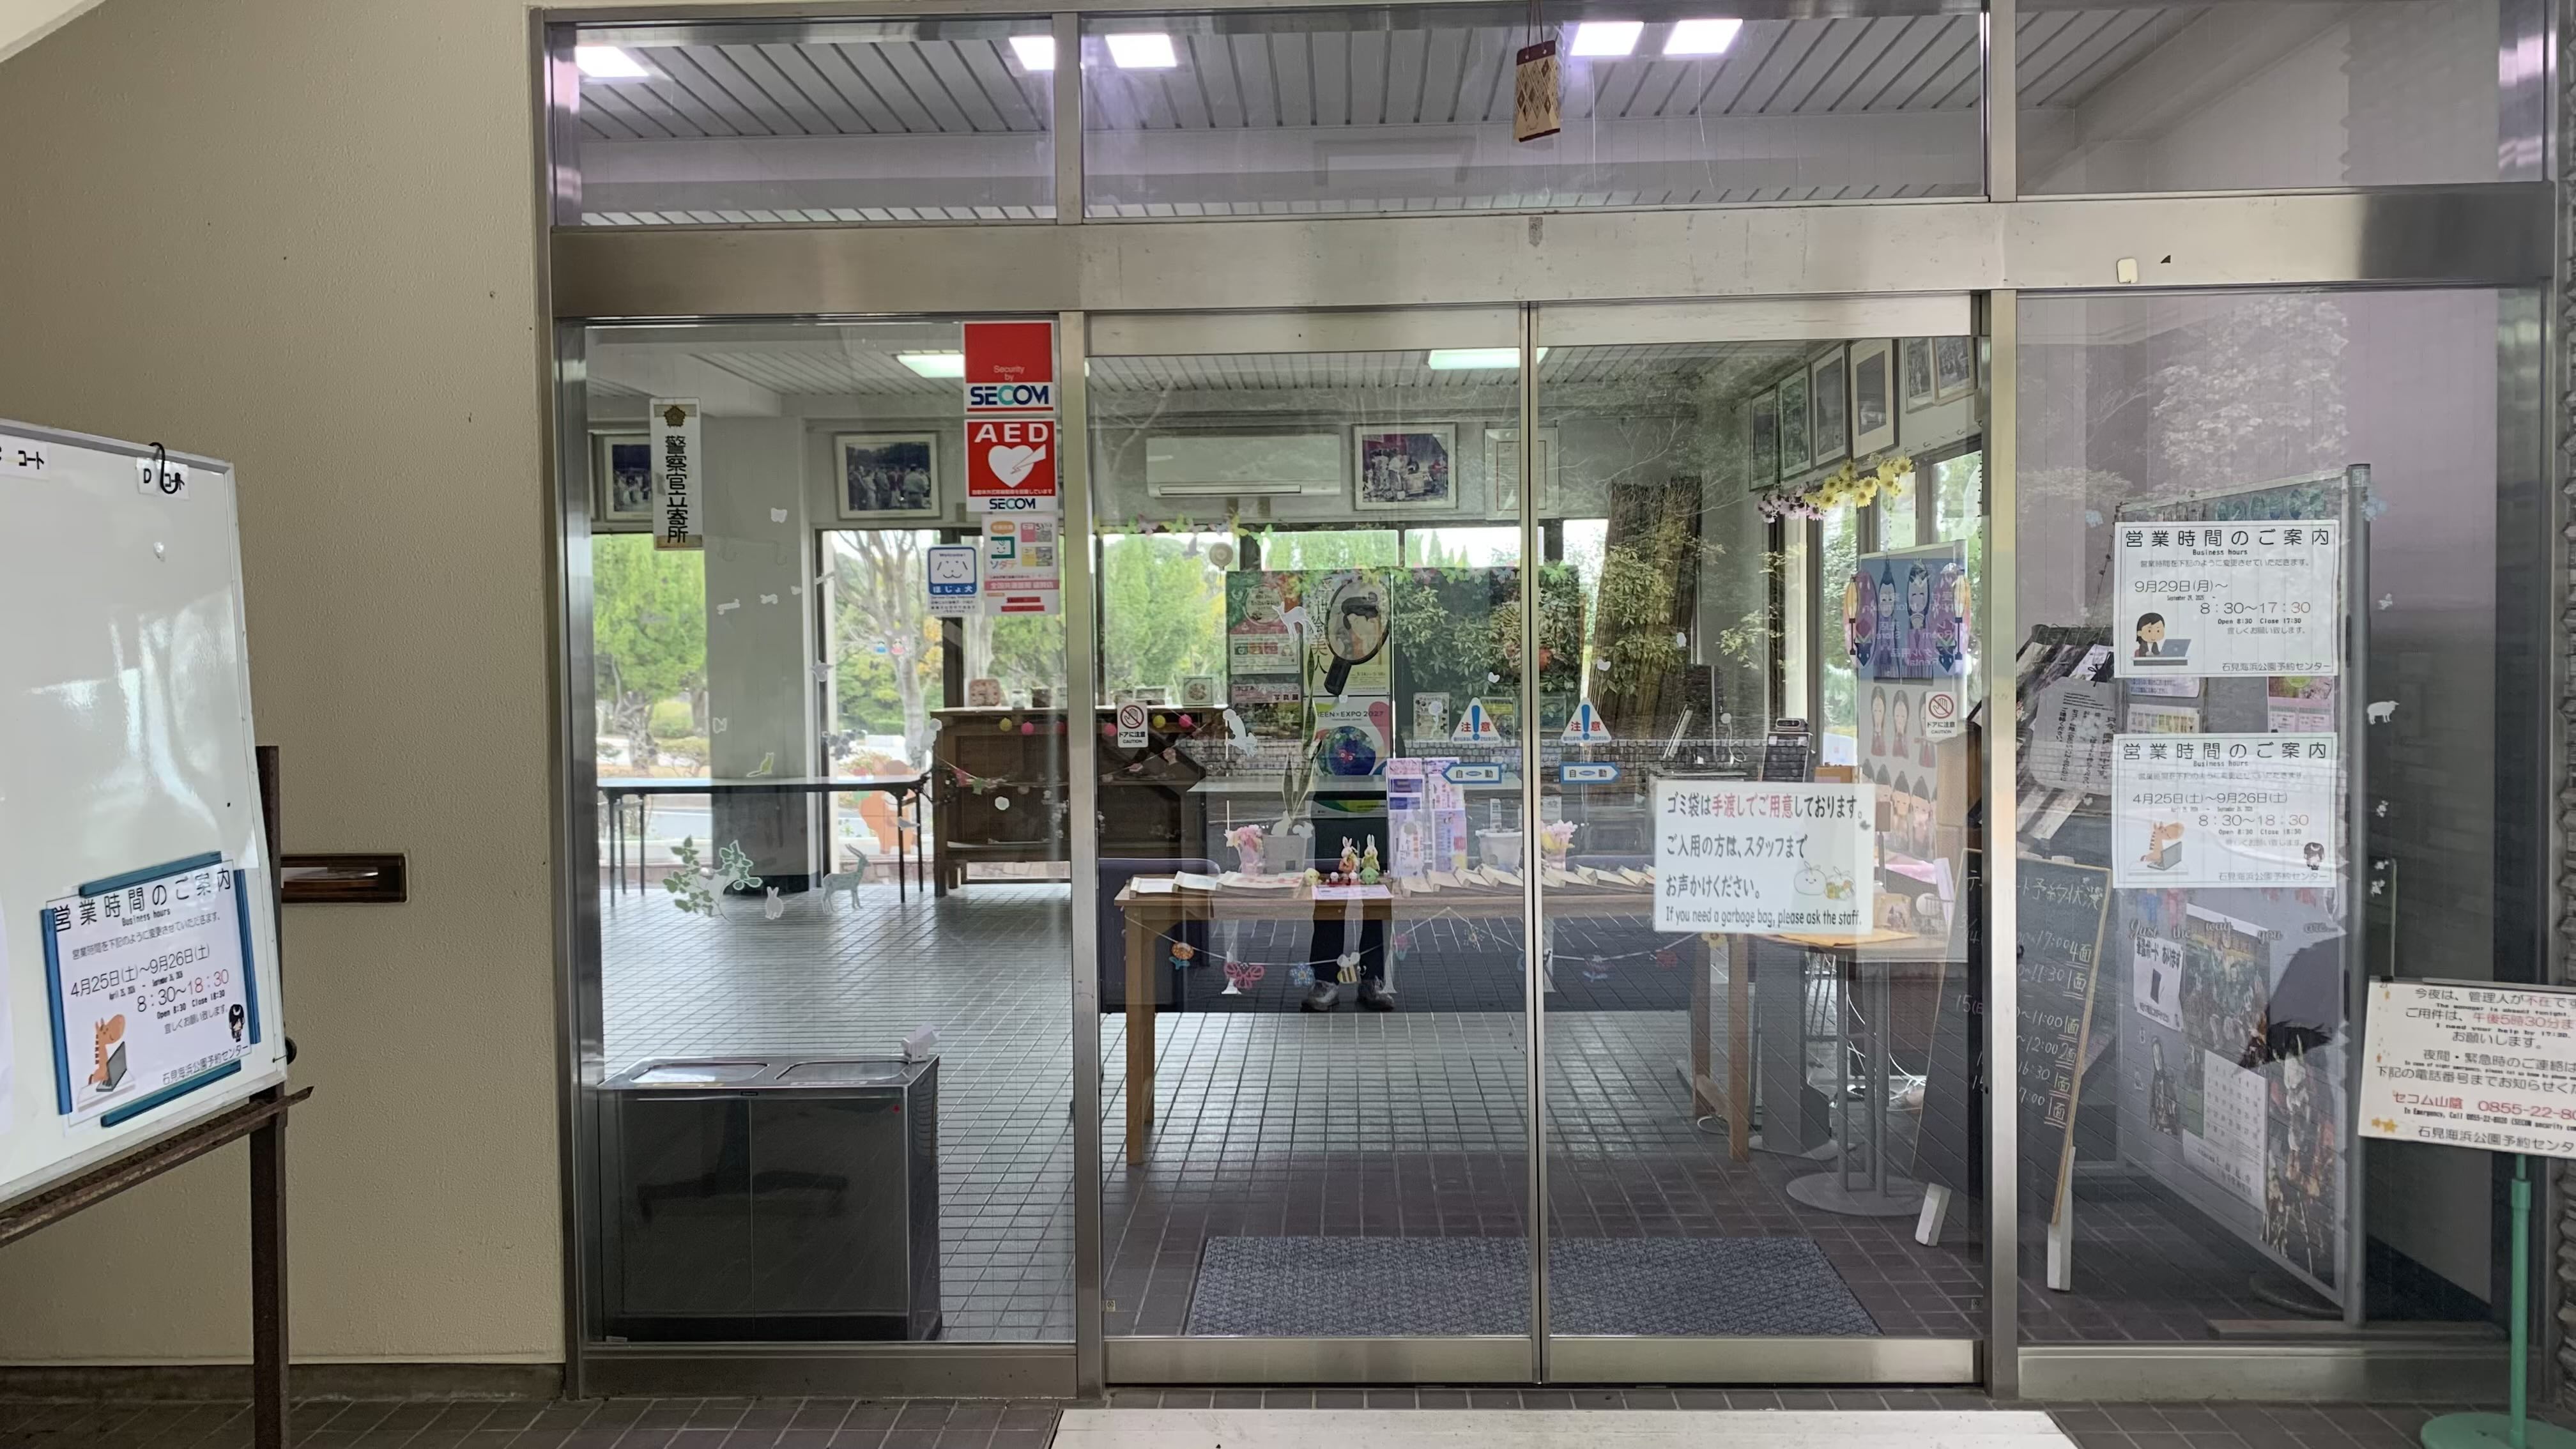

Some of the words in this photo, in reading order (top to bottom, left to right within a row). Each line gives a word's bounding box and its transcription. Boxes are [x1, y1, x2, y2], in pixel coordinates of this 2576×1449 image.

[993, 365, 1025, 374] Security
[1004, 374, 1015, 382] by
[970, 385, 1049, 406] SECOM
[974, 424, 1049, 443] AED
[665, 435, 688, 544] 警察官立寄所
[989, 498, 1036, 510] SECOM
[2125, 528, 2329, 548] 営業時間のご案内
[2221, 661, 2332, 672] 石見海浜公園予約センター
[1927, 720, 1956, 728] ドアに注意
[2123, 742, 2327, 760] 営業時間のご案内
[2228, 759, 2248, 767] hours
[1666, 834, 1808, 859] ご入用の方は、スタッフまで
[1665, 873, 1761, 900] お声かけください。
[54, 867, 231, 932] 営業時間のご案内
[121, 911, 151, 927] Business
[153, 908, 171, 923] hours
[1666, 906, 1674, 923] If
[1676, 908, 1690, 926] you
[1692, 907, 1712, 923] need
[1713, 910, 1719, 923] a
[1721, 908, 1756, 926] garbage
[1758, 909, 1776, 928] bag,
[1777, 909, 1804, 928] please
[1806, 910, 1821, 926] ask
[1823, 910, 1837, 926] the
[1838, 910, 1862, 926] staff.
[2129, 918, 2158, 940] Just
[2172, 926, 2191, 939] the
[2257, 929, 2283, 945] you
[157, 1009, 171, 1020] Open
[173, 1003, 187, 1014] 8:30
[192, 997, 208, 1008] Close
[210, 989, 226, 1000] 18:30
[2452, 1031, 2542, 1050] お願いします。
[2393, 1089, 2464, 1110] セコム山陰
